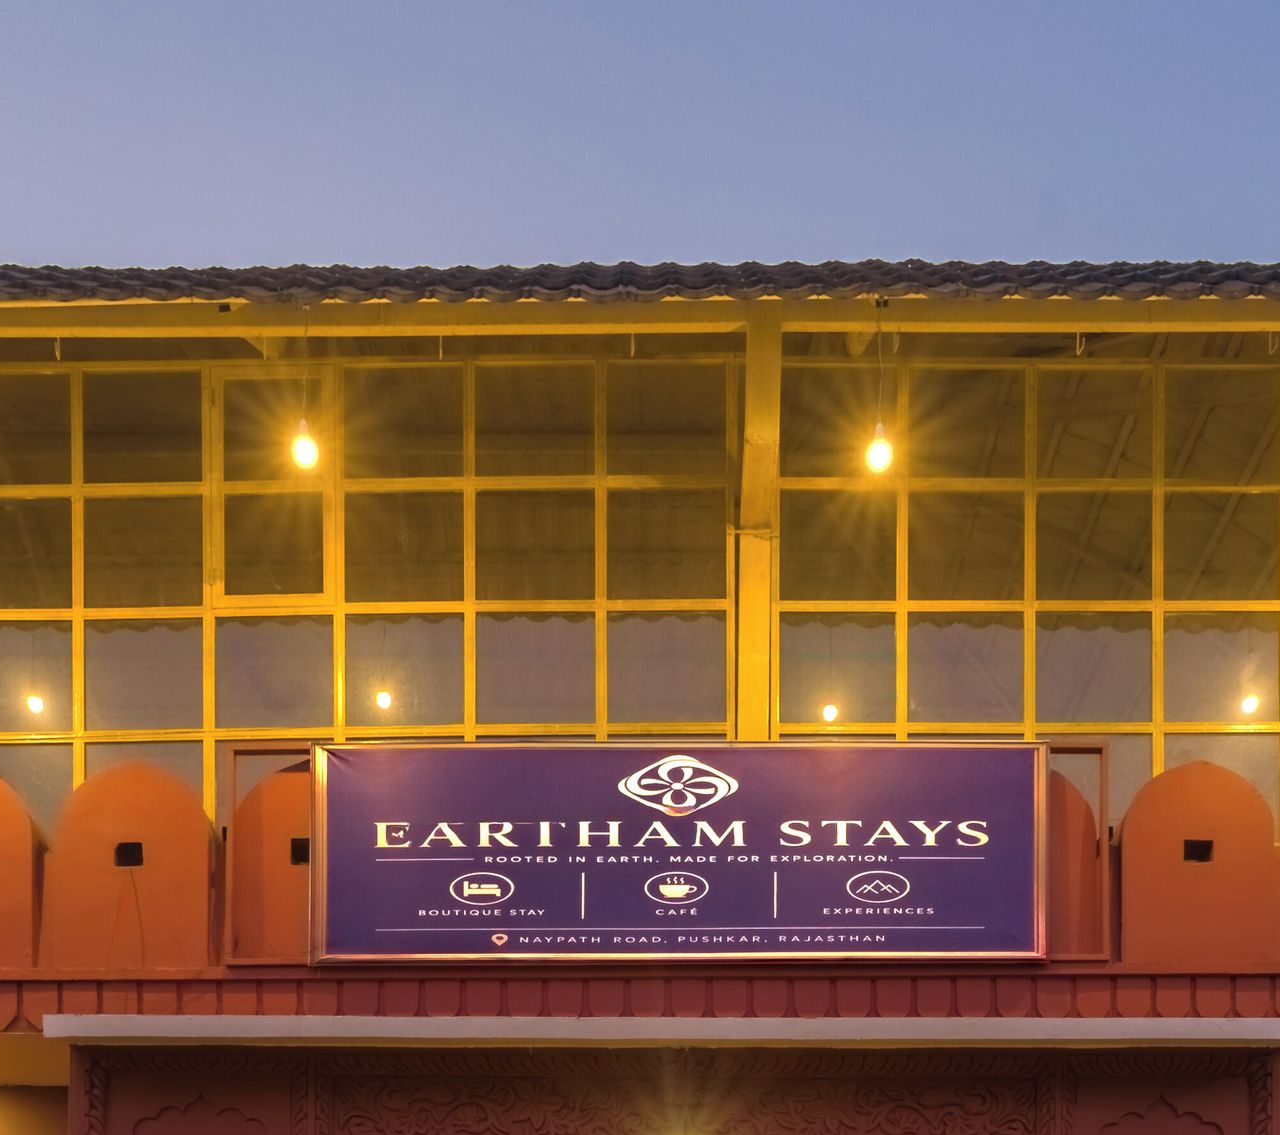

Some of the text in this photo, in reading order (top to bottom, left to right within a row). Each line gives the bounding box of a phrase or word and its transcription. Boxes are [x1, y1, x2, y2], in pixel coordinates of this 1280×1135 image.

[373, 819, 990, 849] EARTHAM STAYS
[484, 854, 894, 864] ROOTED IN EARTH. MADE FOR EXPLORATION.
[418, 908, 546, 917] BOUTIQUE STAY
[655, 907, 698, 916] CAFÉ
[822, 907, 935, 916] EXPERIENCES
[519, 936, 602, 944] NAYPATH
[778, 934, 886, 943] RAJASTHAN
